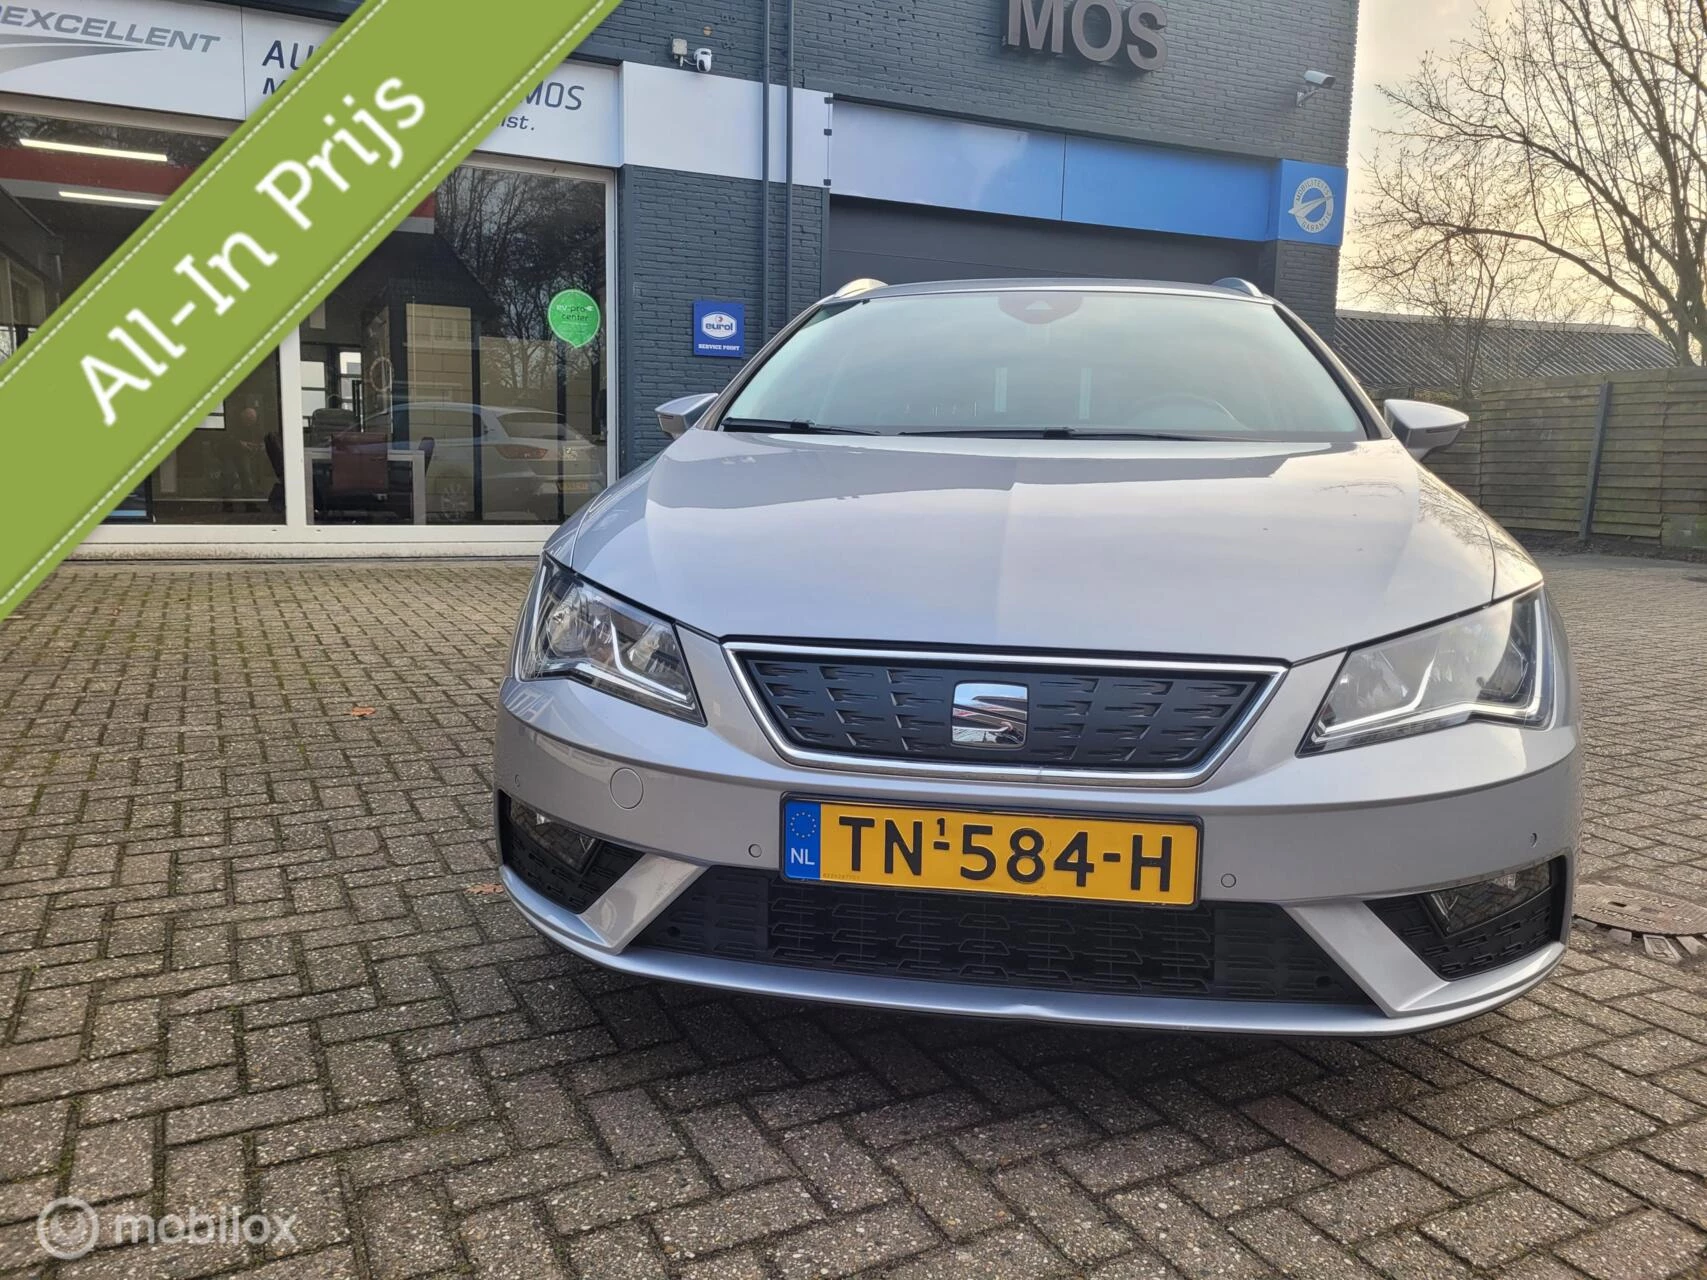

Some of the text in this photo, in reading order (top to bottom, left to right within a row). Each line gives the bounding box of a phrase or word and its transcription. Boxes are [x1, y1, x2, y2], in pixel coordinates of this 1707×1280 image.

[0, 5, 221, 54] EXCELLENT
[1005, 0, 1168, 71] MOS
[705, 322, 733, 331] eurol
[790, 847, 815, 866] NL
